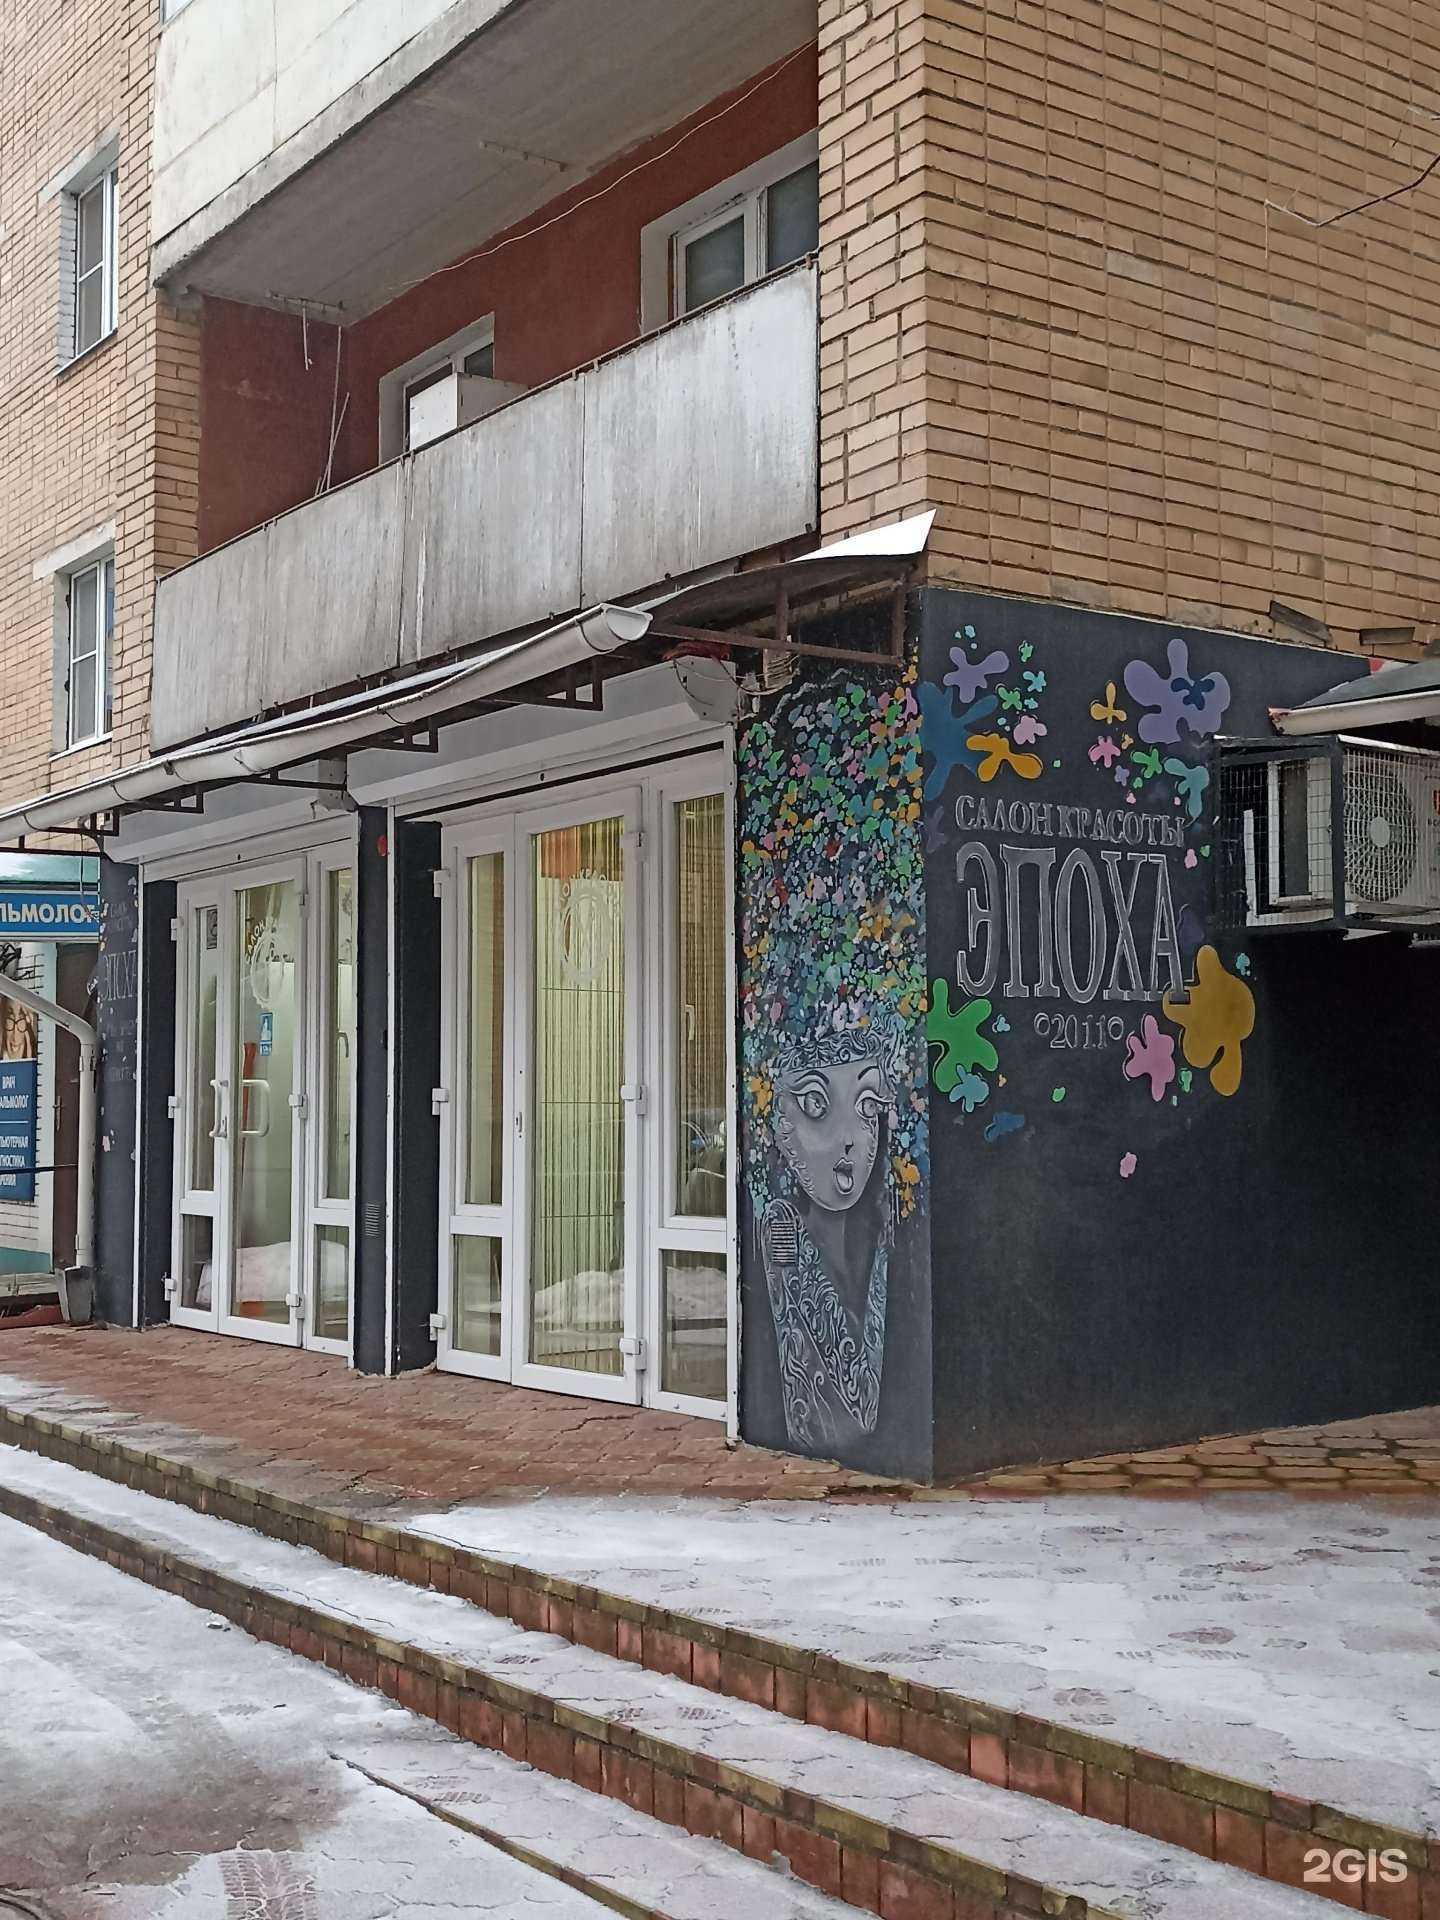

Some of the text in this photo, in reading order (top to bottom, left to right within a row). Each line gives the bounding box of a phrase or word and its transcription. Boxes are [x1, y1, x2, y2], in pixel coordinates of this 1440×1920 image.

[955, 795, 1185, 847] САЛОН КРАСОТЫ
[956, 841, 1190, 1004] ЭПОХА
